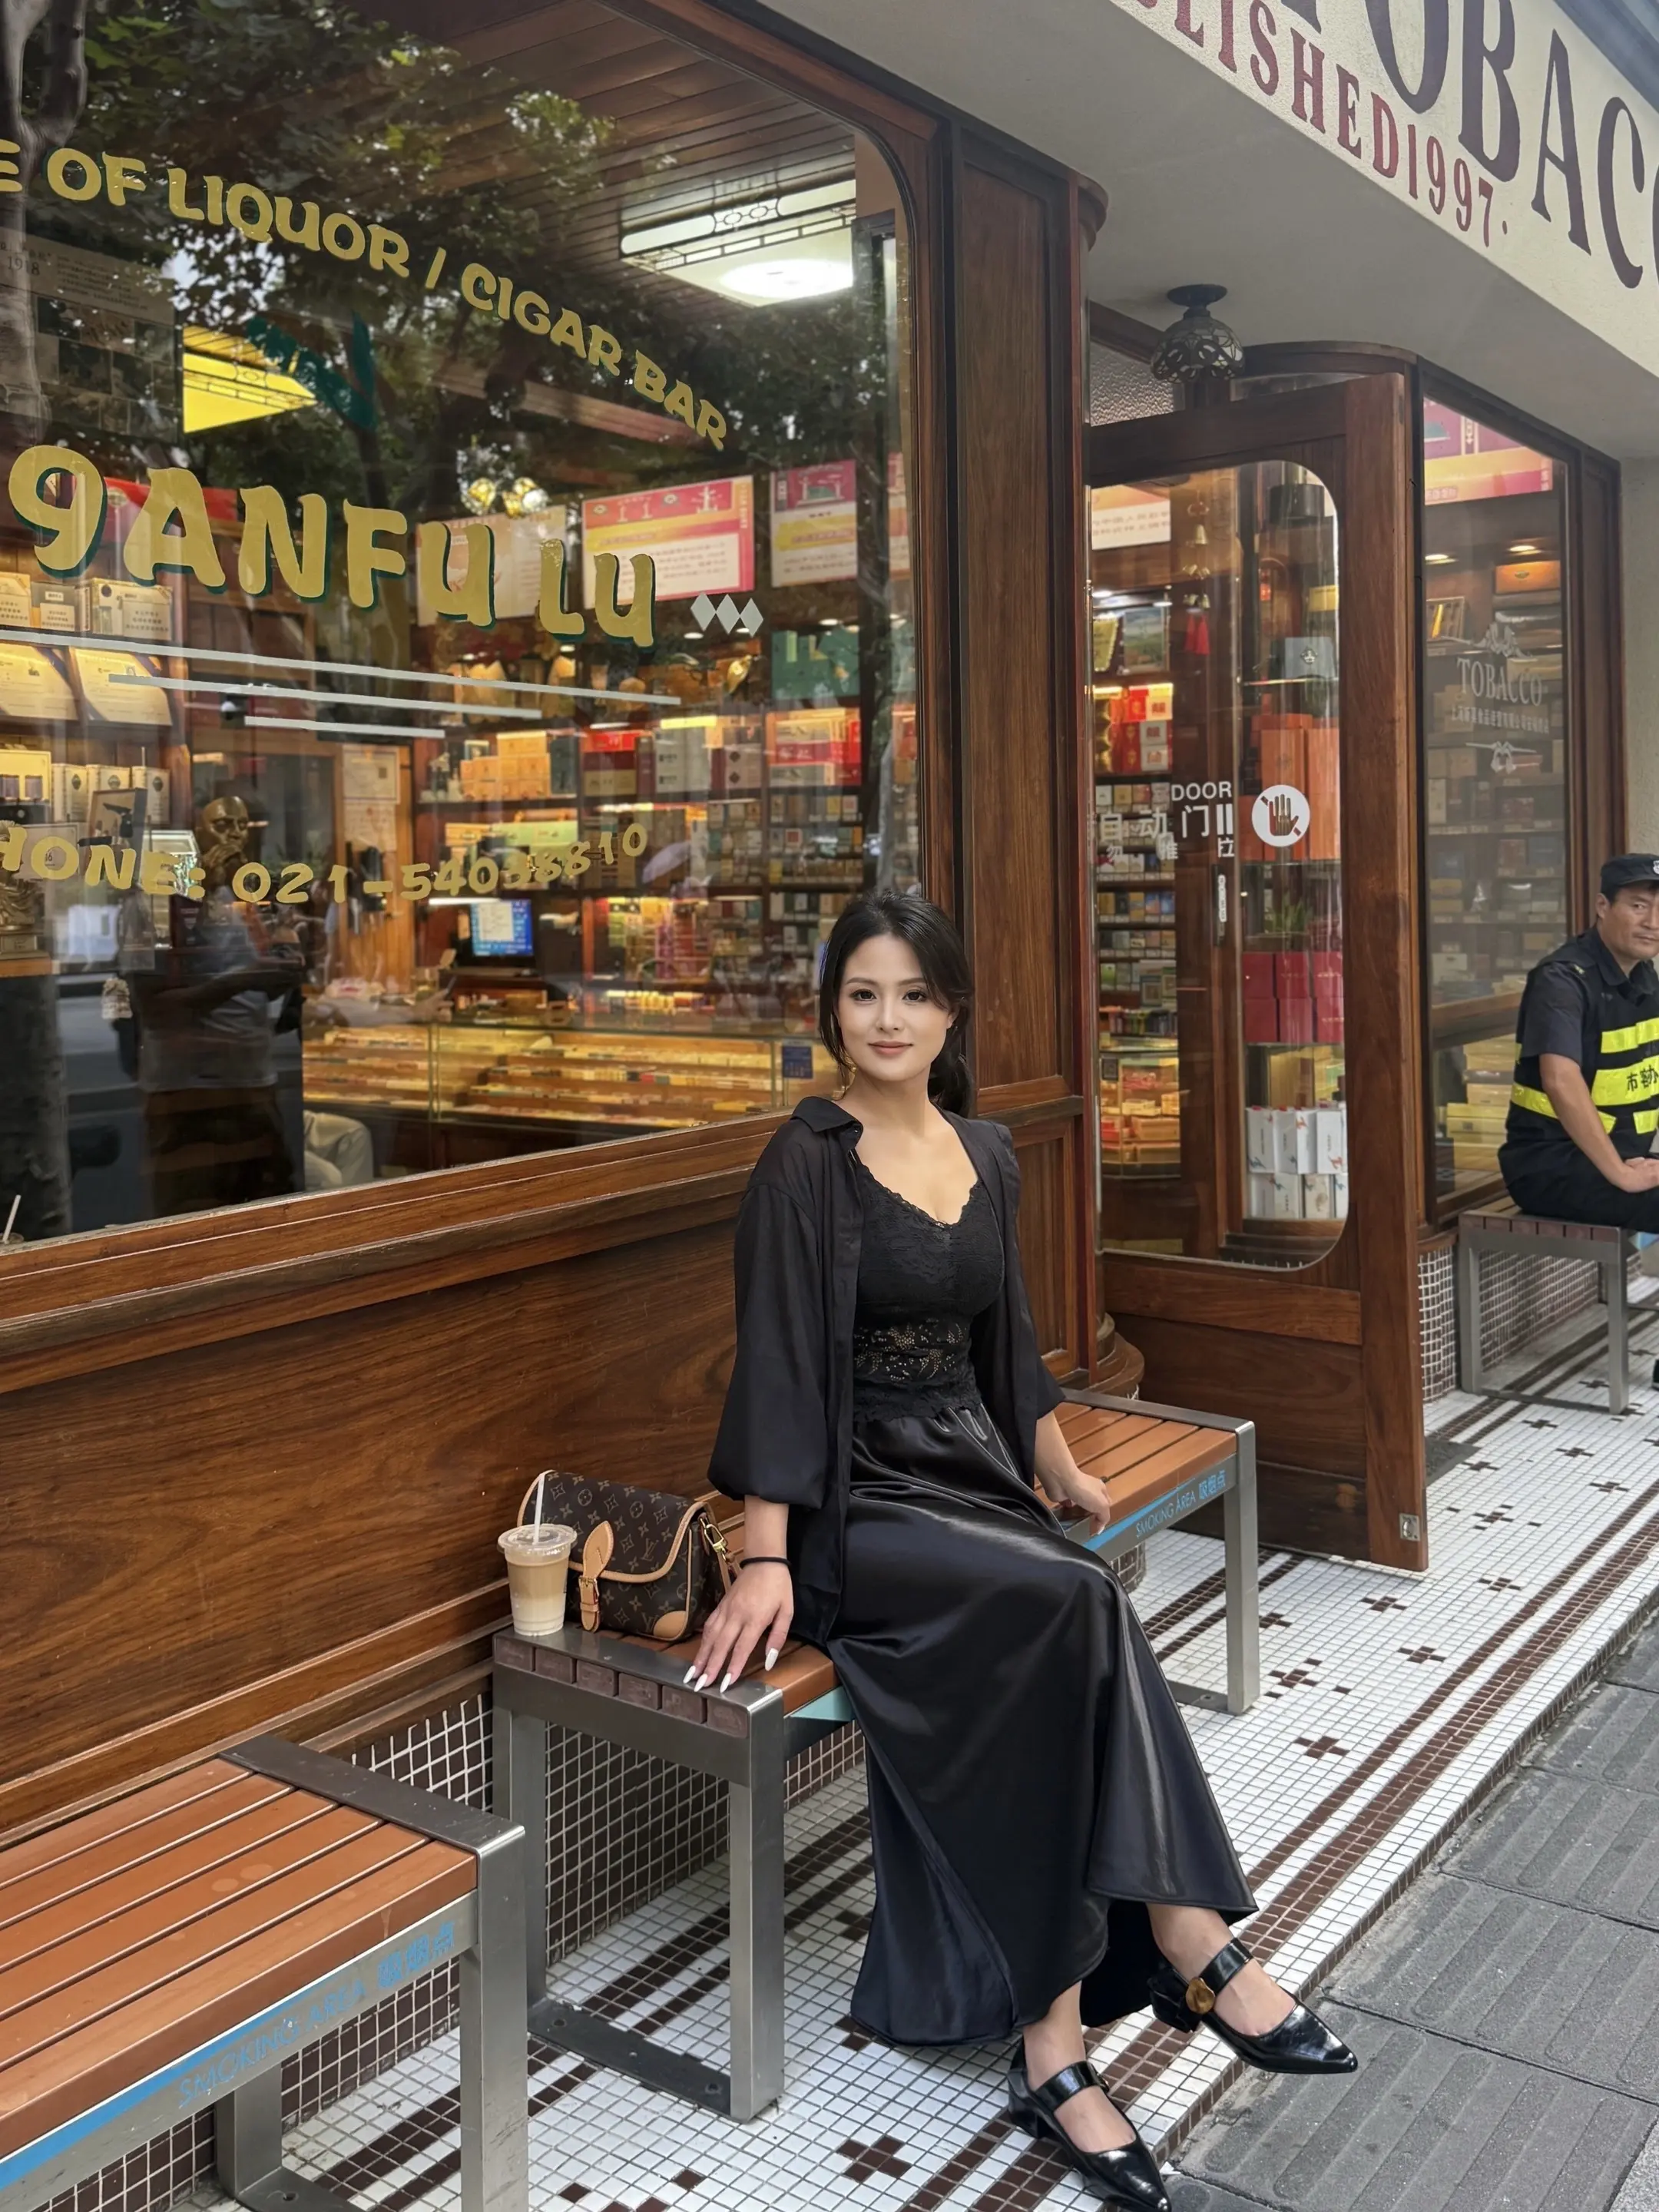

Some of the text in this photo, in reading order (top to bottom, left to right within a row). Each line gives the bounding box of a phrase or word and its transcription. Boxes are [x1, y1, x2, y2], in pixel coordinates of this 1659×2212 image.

[45, 147, 147, 206] OF
[167, 167, 409, 278] LIQUOR
[461, 263, 622, 376] CIGAR
[632, 349, 728, 452] BAR
[1457, 657, 1542, 707] TOBACCO
[1171, 781, 1232, 802] DOOR
[1100, 805, 1210, 844] 自动门
[1136, 1502, 1174, 1539] SMOKING
[1176, 1490, 1197, 1515] AREA
[178, 2017, 300, 2109] SMOKING
[306, 1979, 366, 2032] AREA
